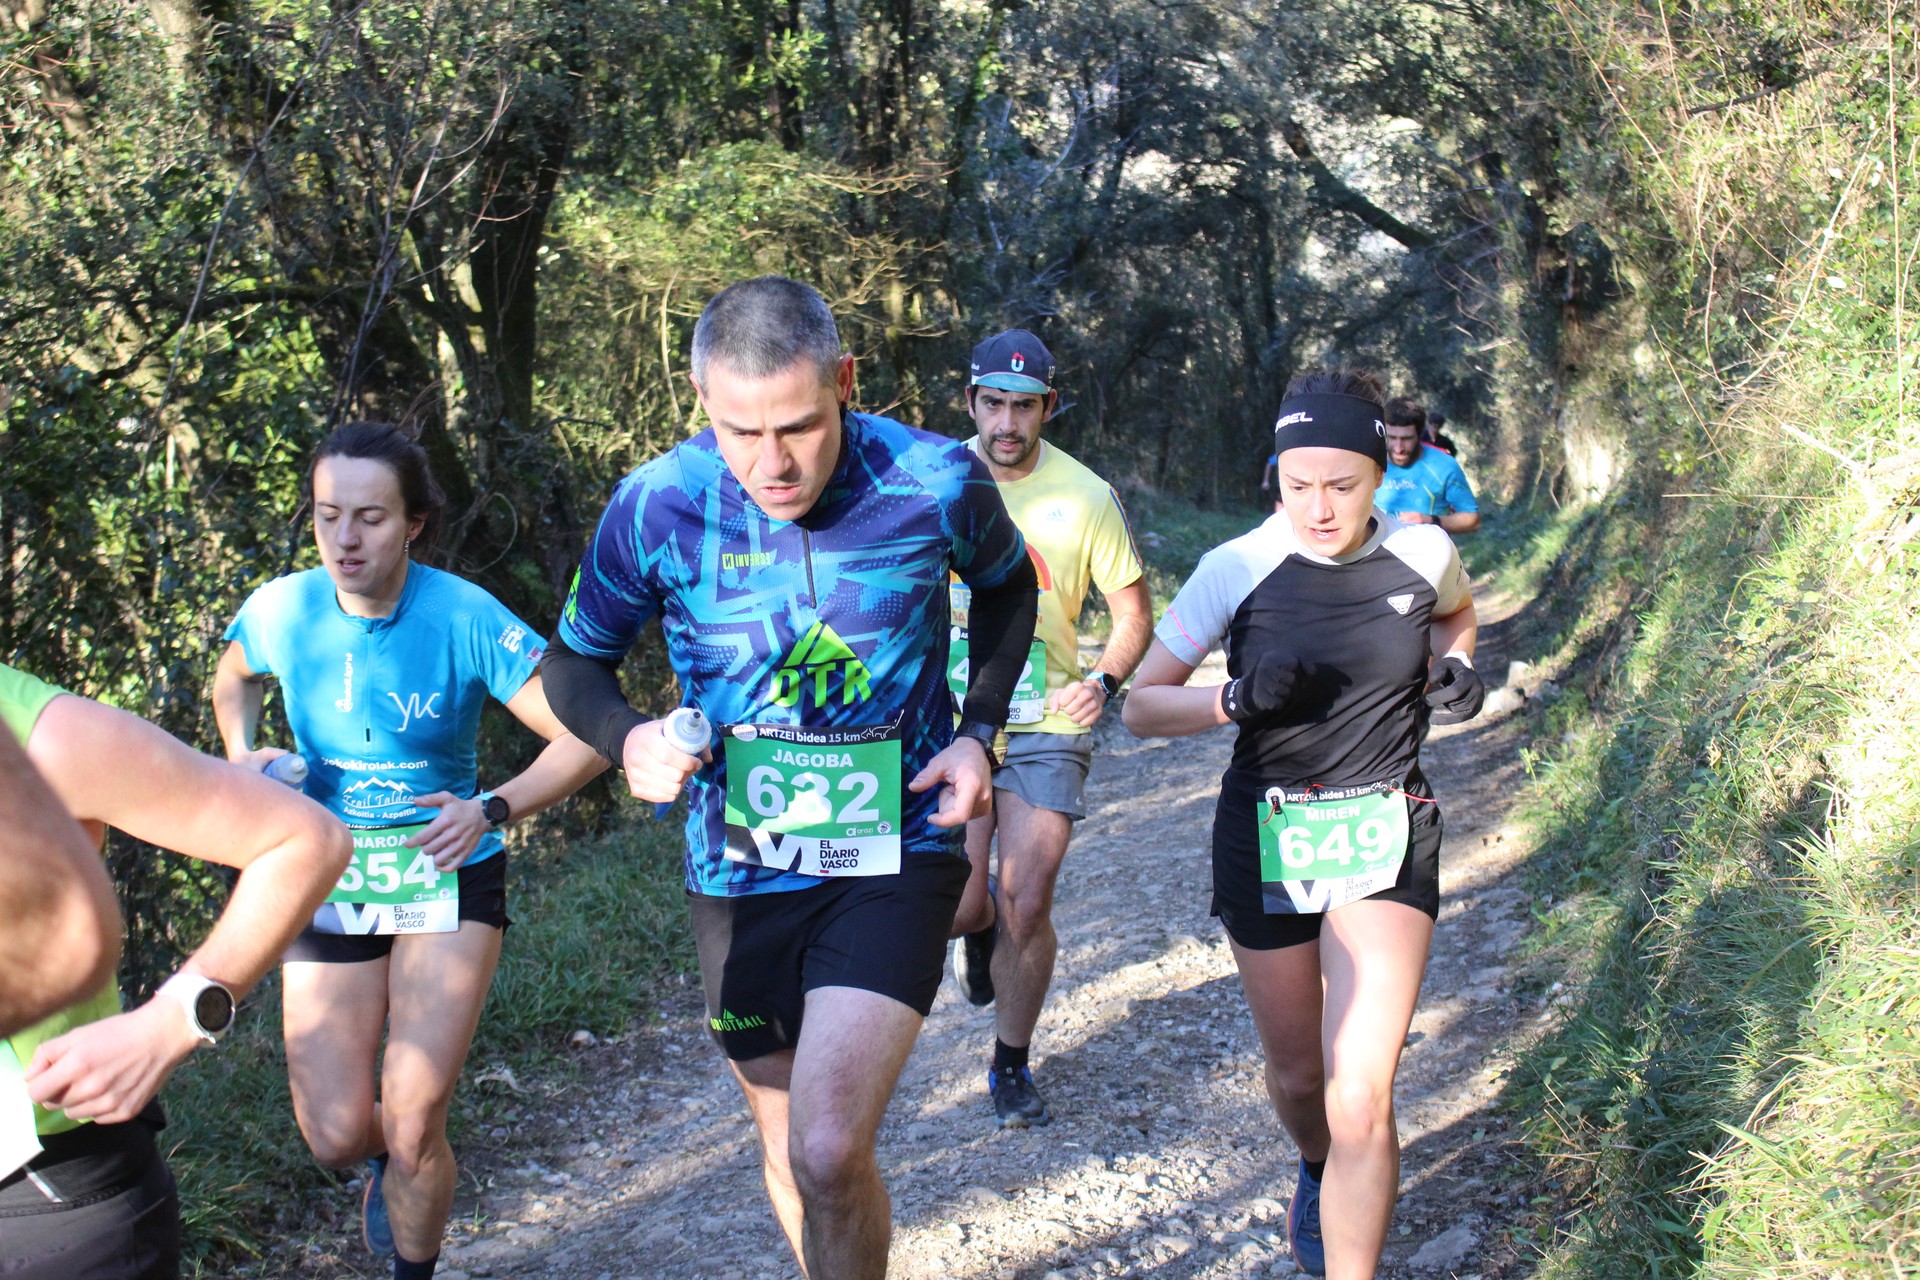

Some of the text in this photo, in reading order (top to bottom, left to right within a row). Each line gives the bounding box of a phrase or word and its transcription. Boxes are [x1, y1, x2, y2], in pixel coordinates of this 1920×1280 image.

[771, 660, 872, 708] OTR
[759, 727, 795, 742] ARTZEI
[796, 732, 827, 744] bidea
[828, 733, 842, 743] 15
[843, 732, 861, 742] km
[771, 749, 854, 768] JAGOBA
[746, 765, 880, 824] 632
[1318, 790, 1344, 800] bidea
[1345, 788, 1357, 798] 15
[1357, 787, 1371, 796] km
[343, 794, 373, 808] Trail
[343, 806, 375, 819] Azkoitia
[382, 807, 417, 820] Azpeitia
[1305, 805, 1360, 822] MIREN
[820, 840, 834, 849] EL
[1279, 818, 1393, 869] 649
[819, 848, 860, 859] DIARIO
[820, 859, 859, 869] VASCO
[336, 850, 441, 894] 654
[394, 905, 405, 913] EL
[394, 911, 426, 921] DIARIO
[395, 919, 425, 929] VASCO
